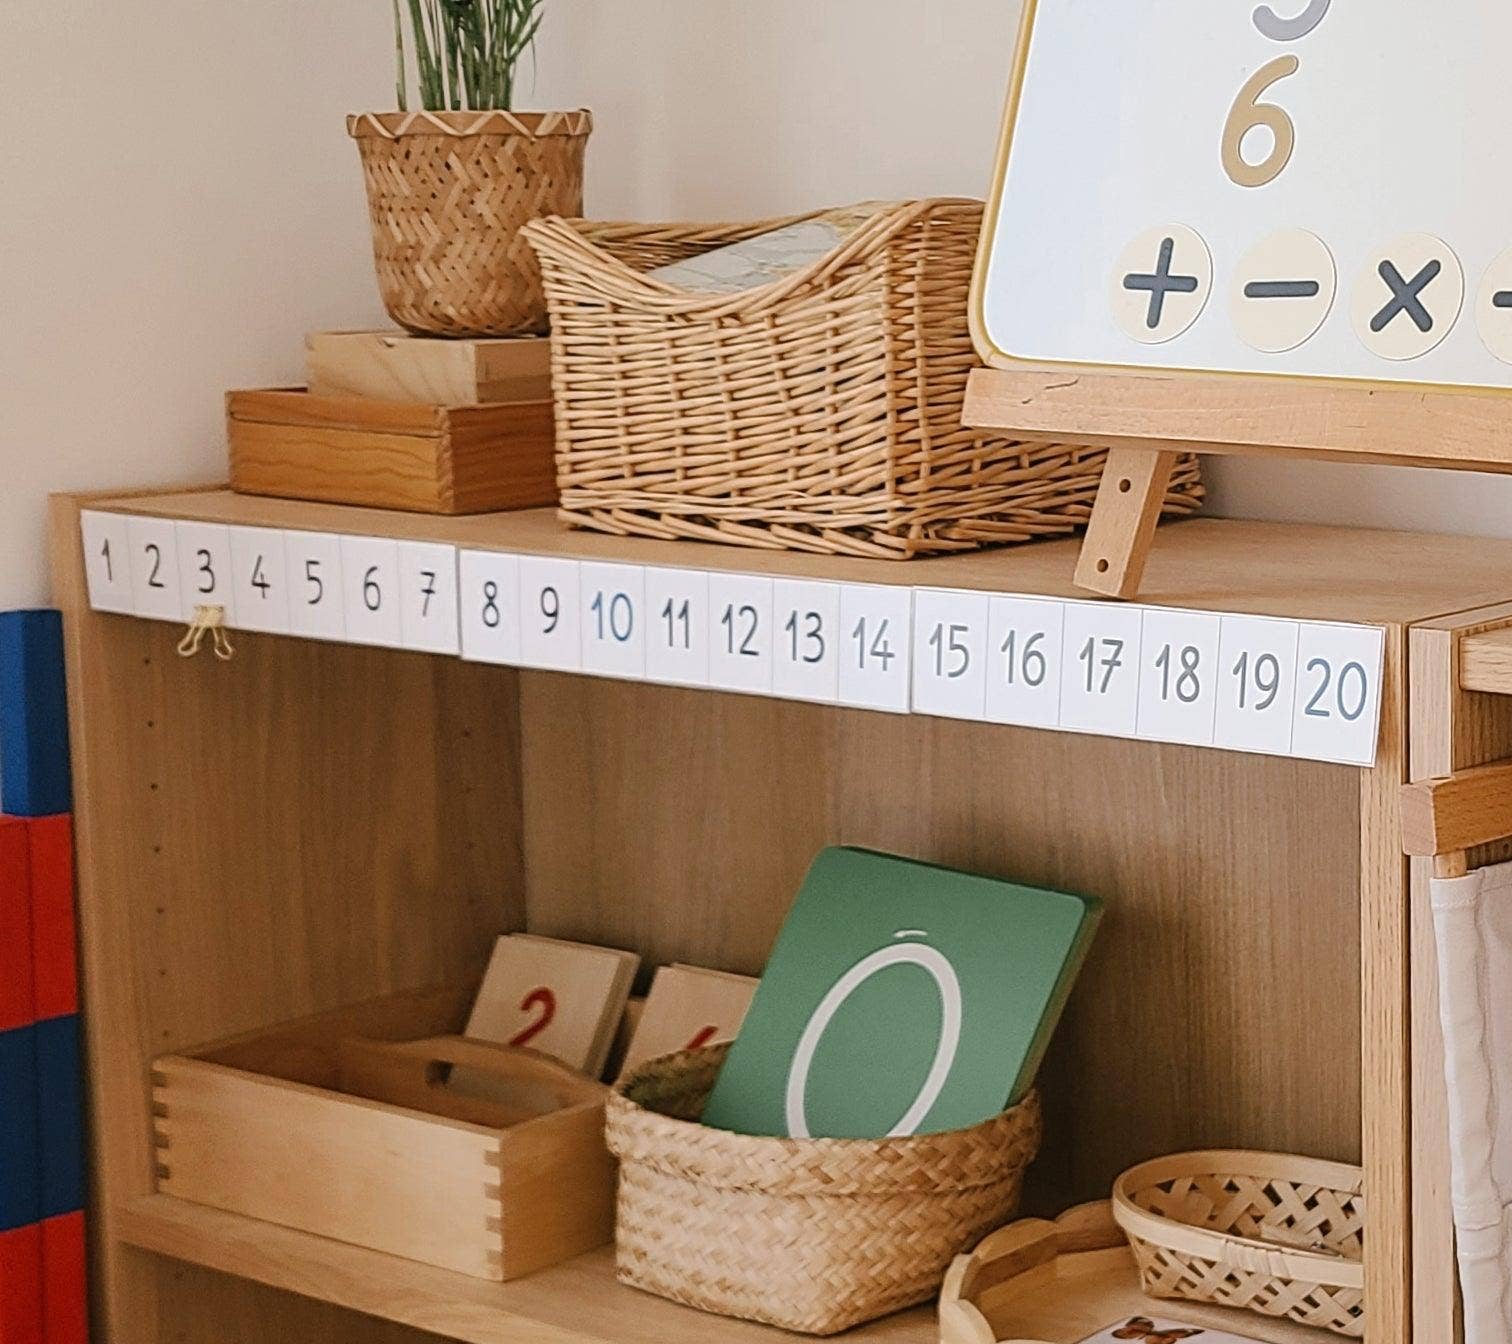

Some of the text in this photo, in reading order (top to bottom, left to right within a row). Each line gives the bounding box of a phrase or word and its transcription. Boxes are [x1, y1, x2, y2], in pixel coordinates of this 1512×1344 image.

[1221, 54, 1299, 187] 6
[102, 539, 1367, 720] 1 2 3 4 5 6 7 8 9 10 11 12 13 14 15 16 17 18 19 20
